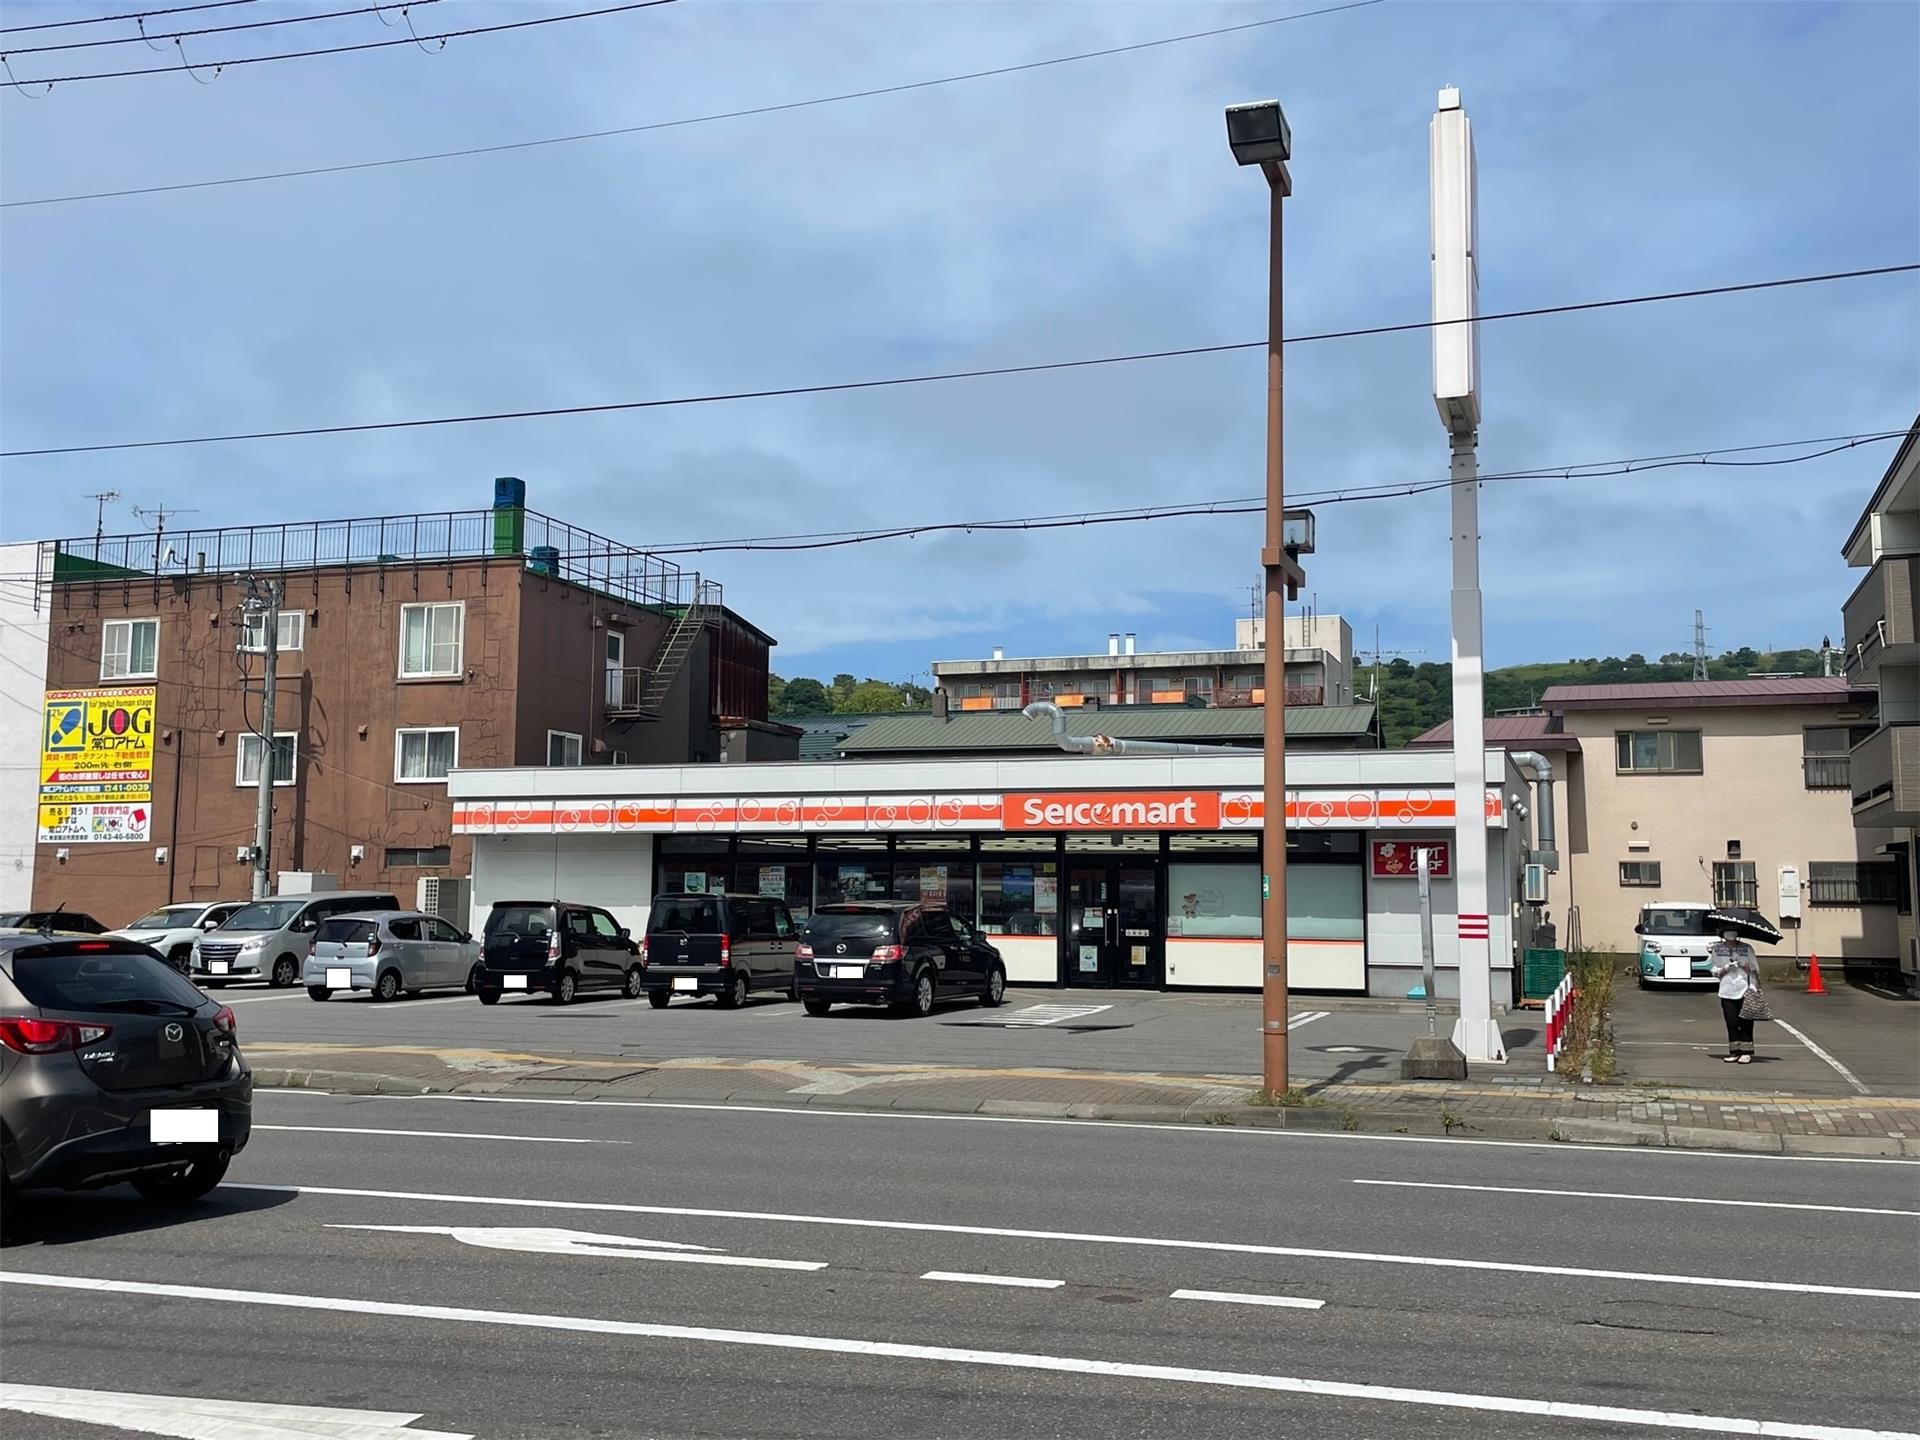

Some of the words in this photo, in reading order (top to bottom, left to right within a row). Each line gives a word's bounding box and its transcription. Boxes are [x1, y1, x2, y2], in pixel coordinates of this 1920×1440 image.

[116, 699, 136, 707] human
[136, 698, 152, 708] stage
[88, 708, 151, 736] JOG
[91, 736, 145, 750] 常口アトム
[1023, 797, 1197, 825] Seicomart
[57, 817, 77, 825] まずは
[1409, 860, 1444, 871] CEF
